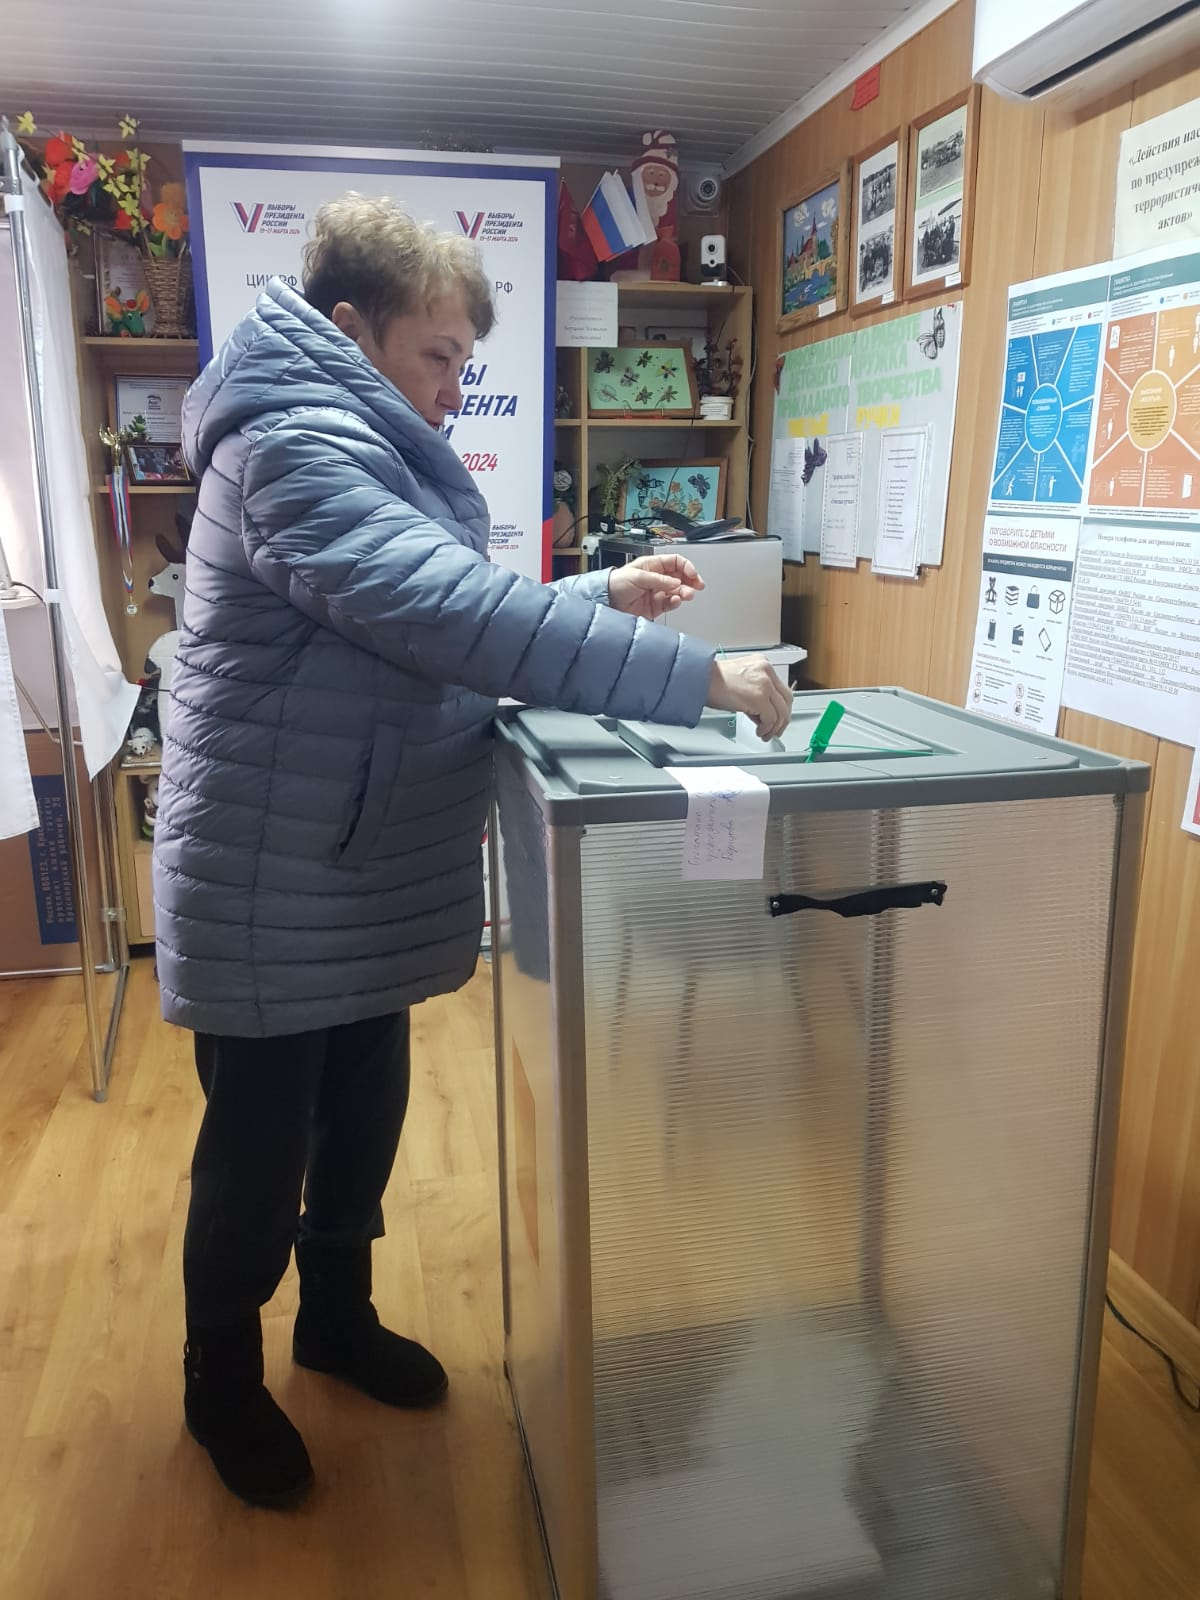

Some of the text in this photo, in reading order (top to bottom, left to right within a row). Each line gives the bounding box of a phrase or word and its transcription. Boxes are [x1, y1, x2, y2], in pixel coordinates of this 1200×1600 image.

[1129, 135, 1180, 166] «Действия
[1131, 178, 1143, 190] по
[264, 212, 305, 220] ПРЕЗИДЕНТА
[487, 212, 516, 220] ВЫБОРЫ
[1158, 211, 1193, 230] актов»
[485, 220, 524, 228] ПРЕЗИДЕНТА
[788, 363, 838, 392] ДЕТСКОГО
[857, 367, 942, 406] ТВОРЧЕСТВА
[856, 405, 901, 429] РУЧКИ
[989, 527, 1025, 538] ПОГОВОРИТЕ
[1030, 529, 1055, 539] ДЕТЬМИ
[993, 539, 1030, 550] ВОЗМОЖНОЙ
[1030, 541, 1067, 552] ОПАСНОСТИ
